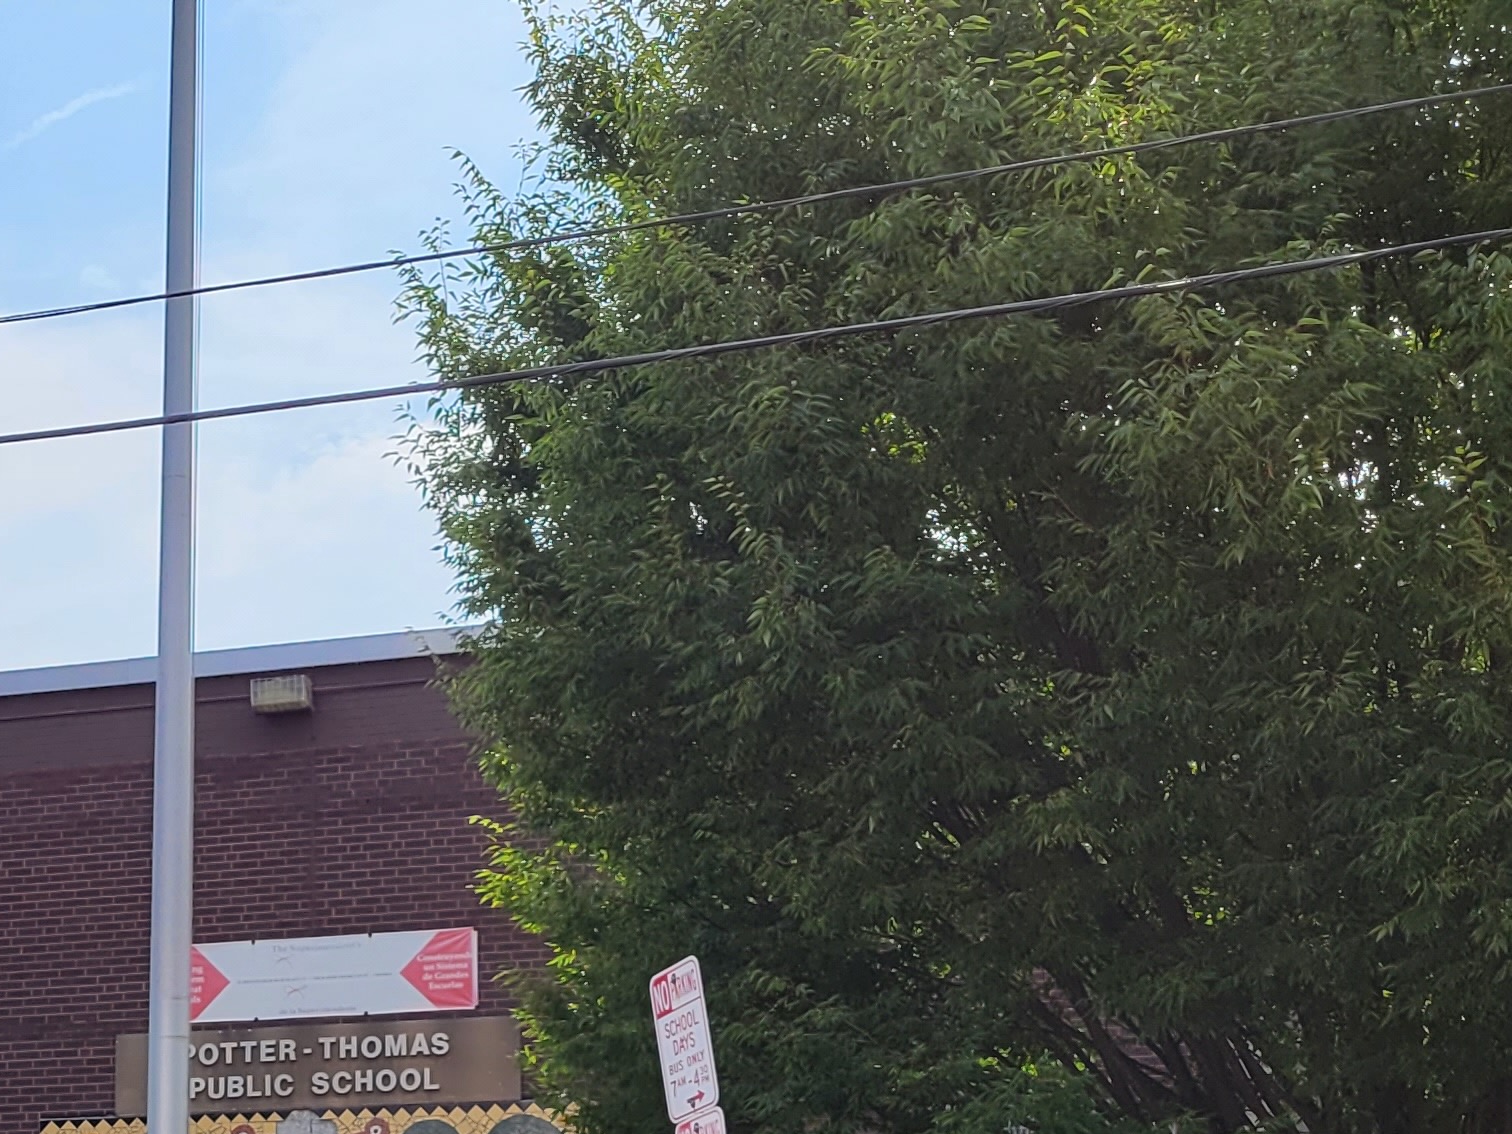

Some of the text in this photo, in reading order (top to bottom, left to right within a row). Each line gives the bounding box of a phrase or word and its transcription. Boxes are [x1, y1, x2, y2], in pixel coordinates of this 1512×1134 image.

[653, 980, 669, 1014] NO
[665, 1009, 700, 1039] SCHOOL
[673, 1032, 696, 1056] DAYS
[669, 1049, 705, 1076] BUS ONLY
[189, 1067, 441, 1100] PUBLIC SCHOOL
